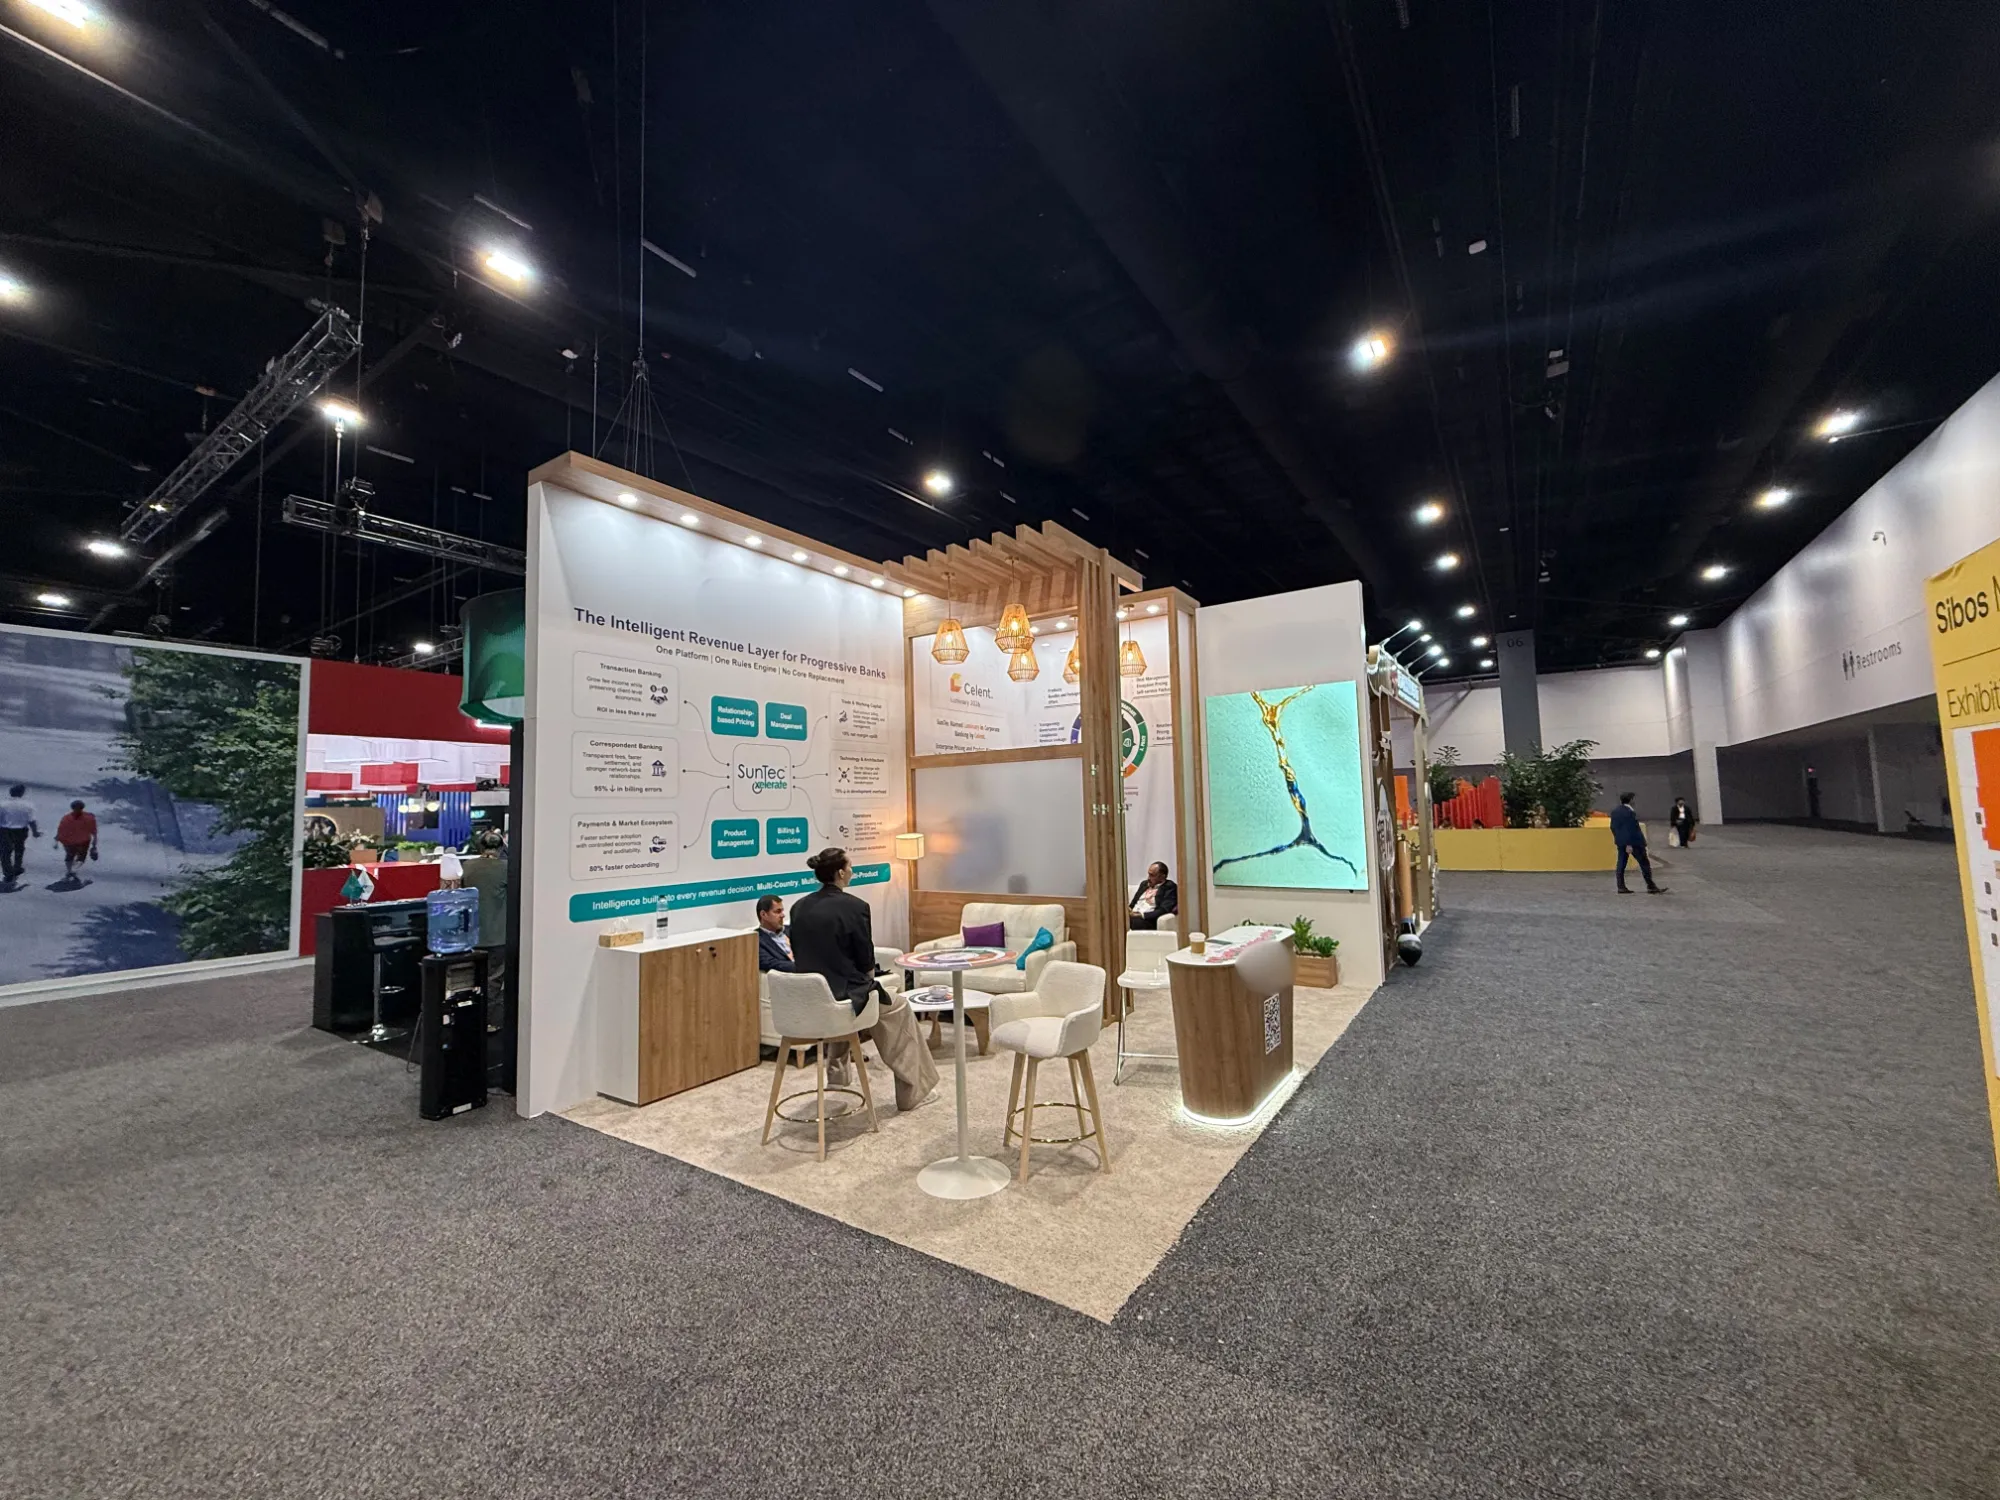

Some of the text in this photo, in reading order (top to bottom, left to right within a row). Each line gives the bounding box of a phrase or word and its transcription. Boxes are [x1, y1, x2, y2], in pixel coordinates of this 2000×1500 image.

[1936, 591, 1989, 634] Sibos
[574, 607, 886, 680] The Intelligent Revenue Layer for Progressive Banks
[1507, 638, 1524, 648] 06
[1856, 641, 1901, 670] Restrooms
[656, 645, 673, 655] One
[675, 649, 709, 661] Platform
[715, 656, 730, 665] One
[732, 659, 752, 669] Rules
[754, 663, 777, 673] Engine
[783, 667, 791, 676] No
[792, 669, 807, 678] Core
[808, 672, 845, 684] Replacement
[600, 663, 662, 678] Transaction Banking
[1947, 679, 2000, 718] Exhibit
[717, 706, 755, 717] Relationship-
[780, 712, 793, 720] Deal
[716, 716, 755, 728] based Pricing
[770, 720, 803, 730] Management
[590, 740, 663, 751] Correspondent Banking
[582, 751, 614, 760] Transparent
[738, 764, 786, 782] SunTec
[624, 785, 643, 793] billing
[577, 821, 610, 829] Payments
[641, 819, 673, 827] Ecosystem
[723, 829, 747, 837] Product
[777, 827, 795, 835] Billing
[717, 839, 755, 848] Management
[625, 861, 660, 869] onboarding
[592, 899, 641, 911] Intelligence
[642, 894, 659, 905] built
[677, 891, 697, 902] every
[699, 888, 726, 898] revenue
